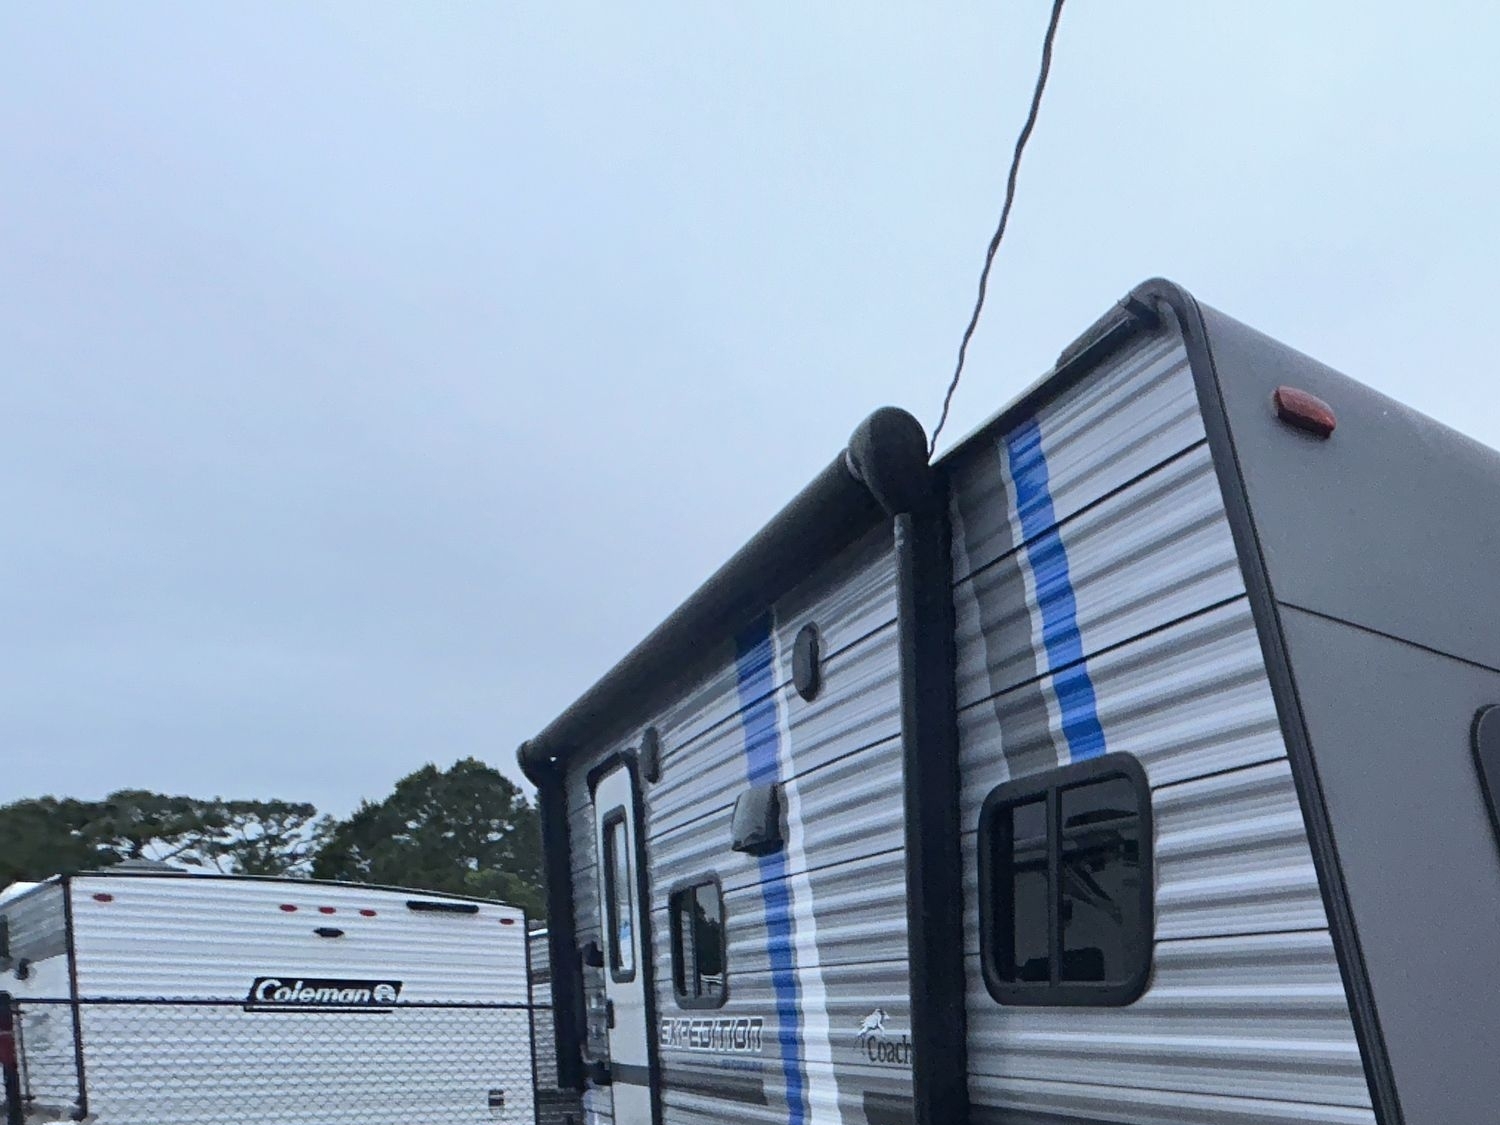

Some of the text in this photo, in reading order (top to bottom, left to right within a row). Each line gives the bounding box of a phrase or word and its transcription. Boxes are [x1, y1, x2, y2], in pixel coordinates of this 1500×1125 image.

[255, 978, 371, 1004] Coleman
[659, 1015, 764, 1053] EXPEDITION
[867, 1034, 912, 1065] Coach
